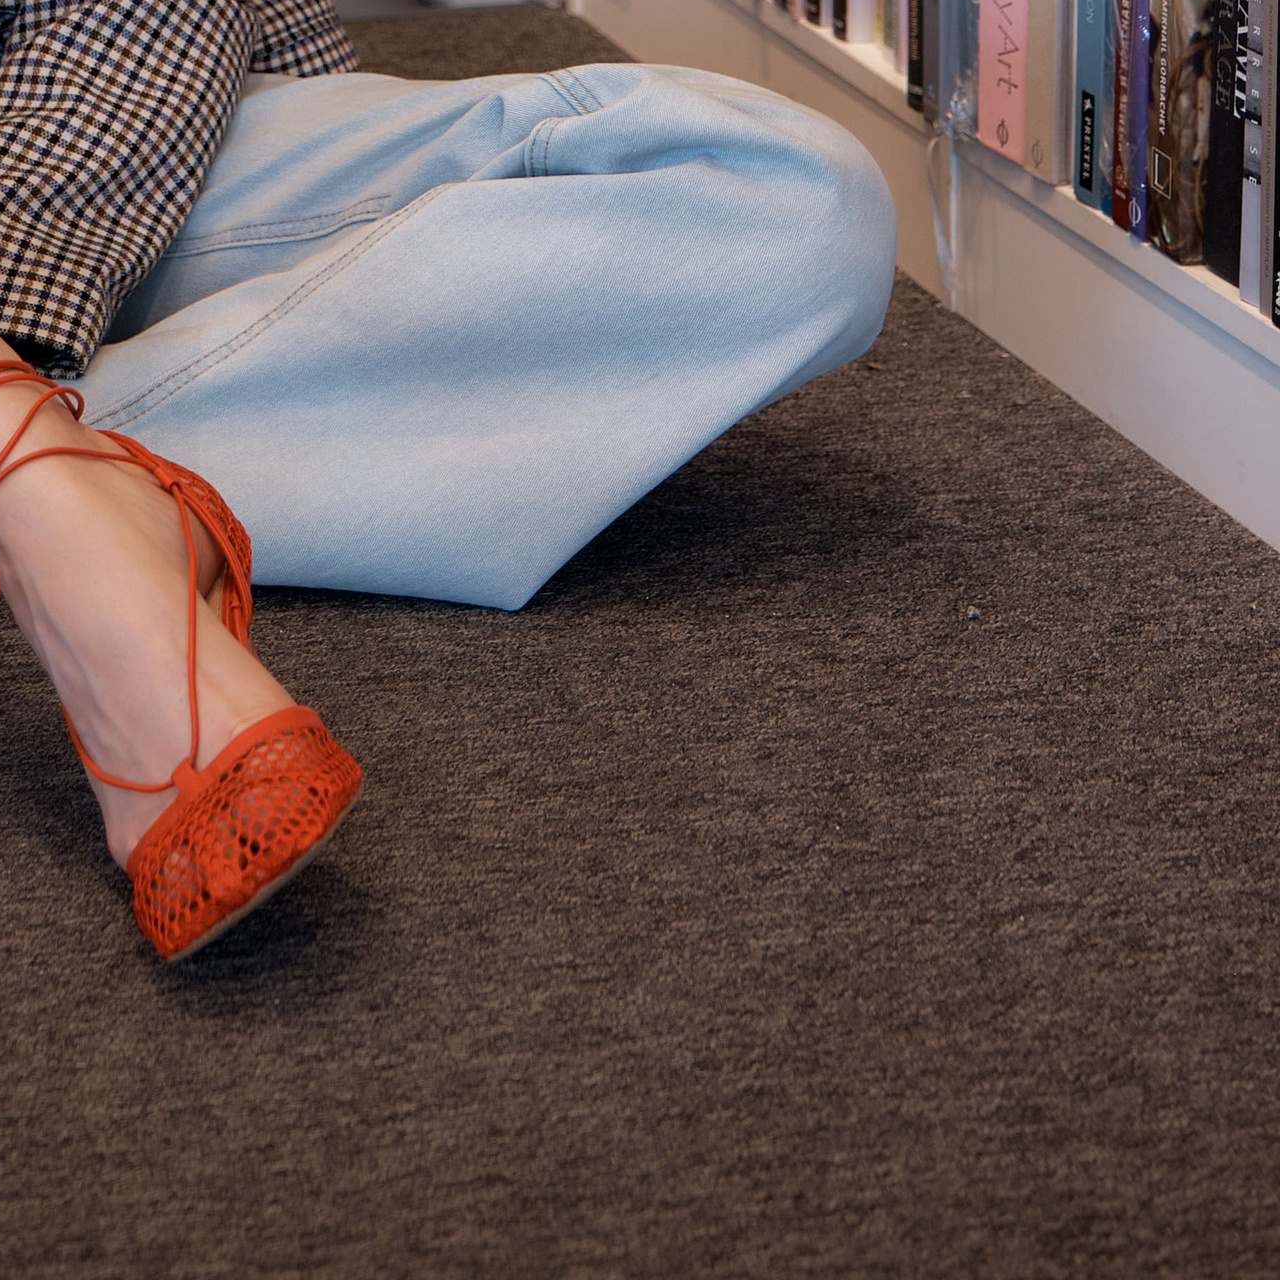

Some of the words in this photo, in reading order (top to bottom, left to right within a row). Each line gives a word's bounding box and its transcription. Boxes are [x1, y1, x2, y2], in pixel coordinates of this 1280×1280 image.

[996, 25, 1020, 95] Art
[1158, 57, 1168, 136] GORBACHEV
[1215, 29, 1236, 112] AGE
[1082, 115, 1092, 180] PRESTEL
